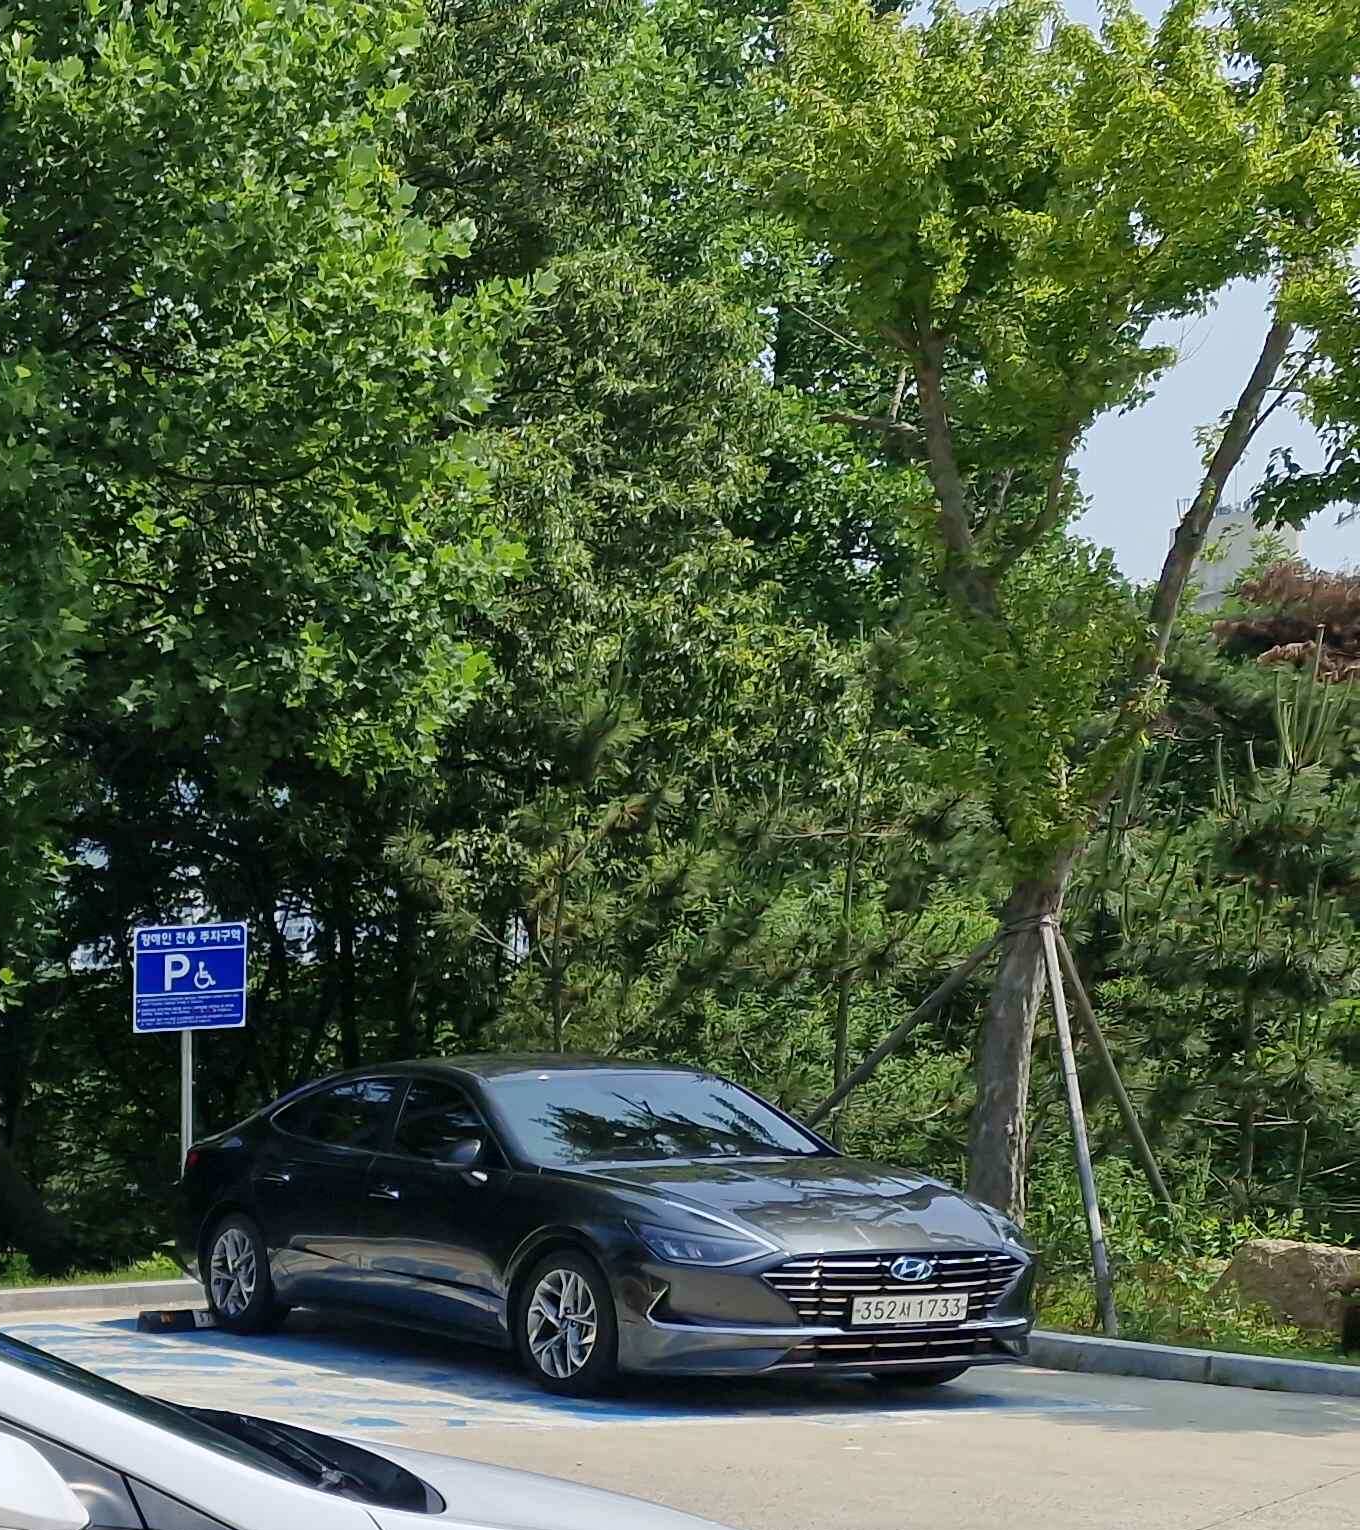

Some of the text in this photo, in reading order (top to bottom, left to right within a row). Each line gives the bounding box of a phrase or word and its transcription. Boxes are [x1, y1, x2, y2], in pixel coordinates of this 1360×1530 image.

[140, 929, 241, 947] 장애인 전용 주차구역
[164, 953, 190, 992] P
